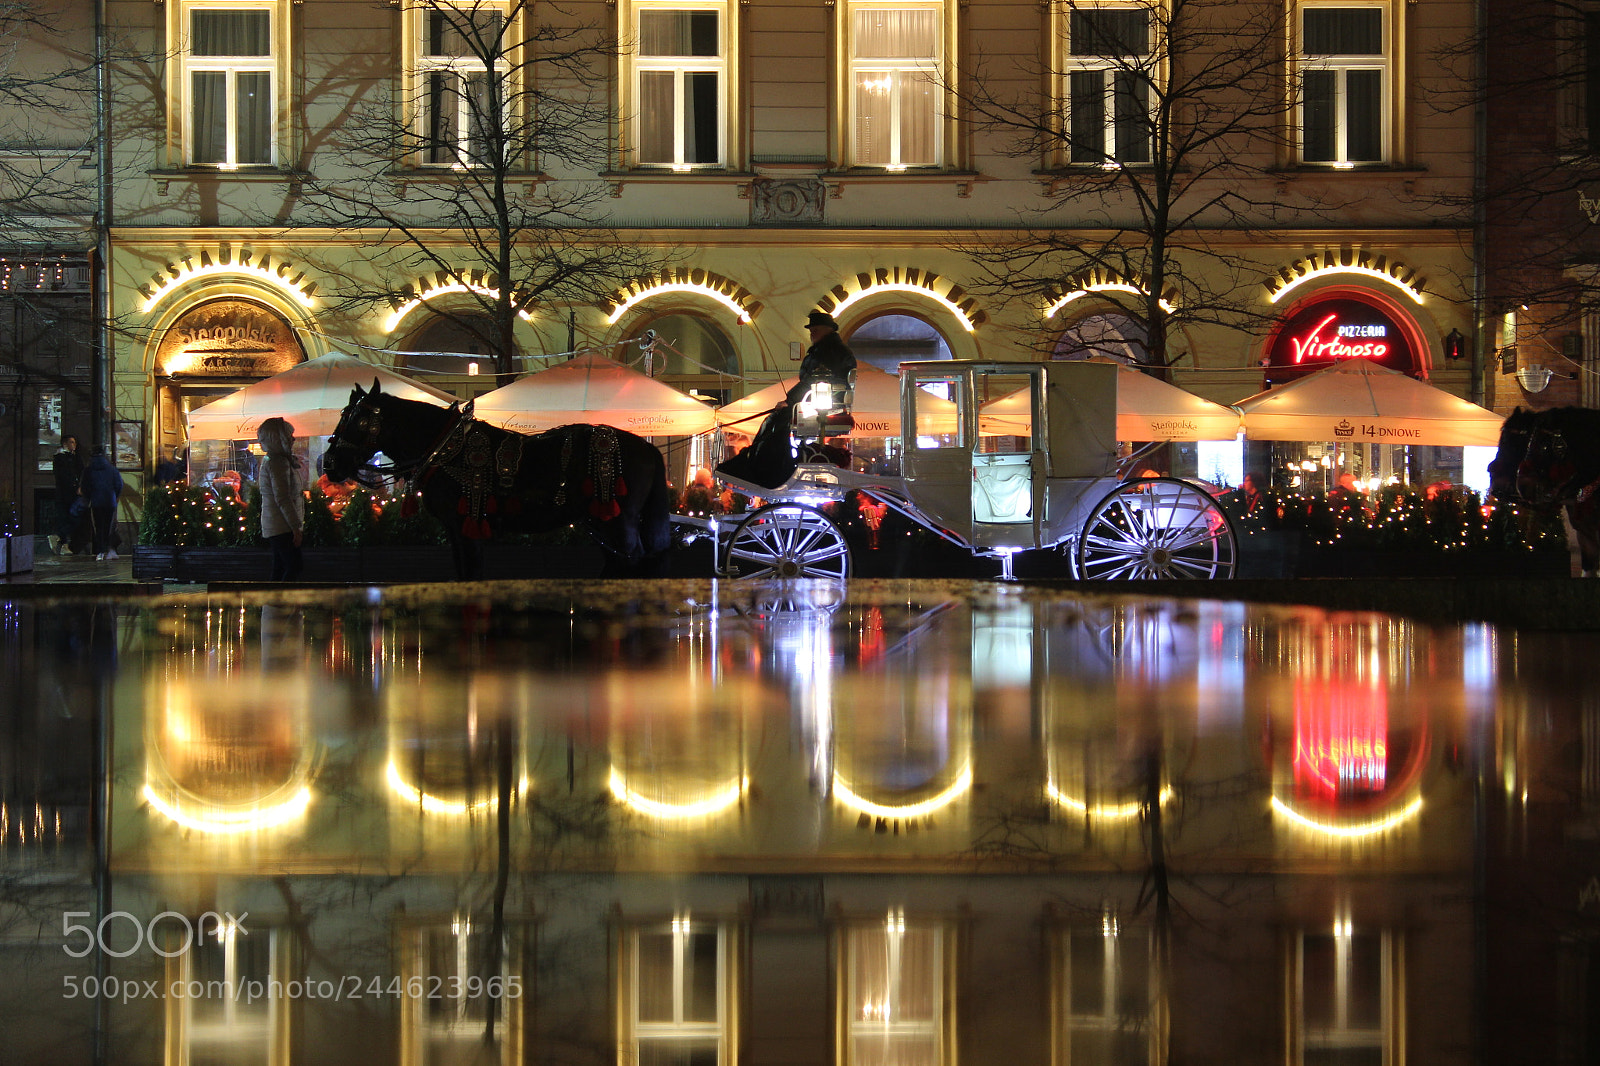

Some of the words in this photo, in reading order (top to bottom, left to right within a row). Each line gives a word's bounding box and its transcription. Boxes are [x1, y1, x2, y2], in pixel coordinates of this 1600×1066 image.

[178, 322, 276, 345] Staropolska
[1292, 314, 1387, 363] Virtuoso
[1338, 325, 1387, 337] PIZZERIA
[853, 422, 890, 431] NIOWE
